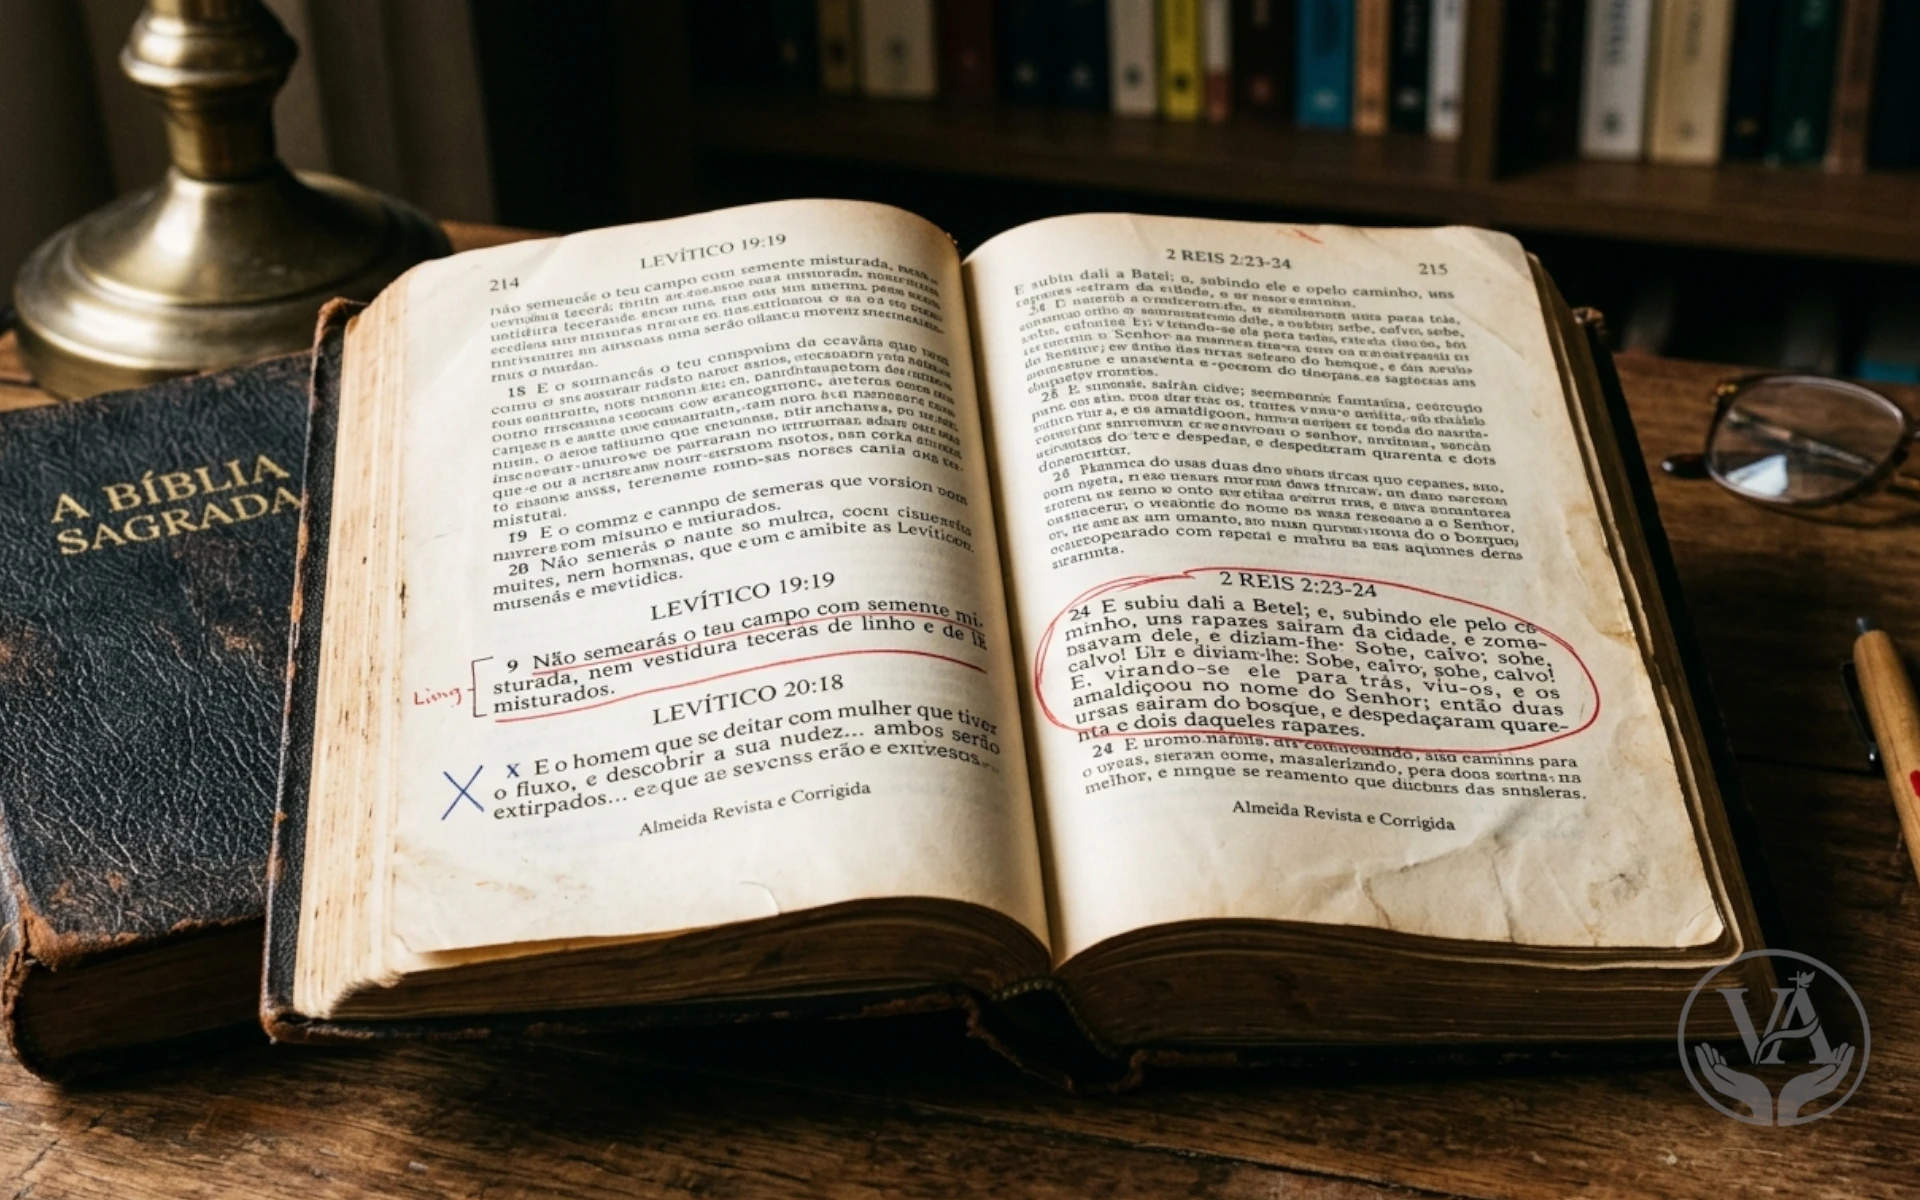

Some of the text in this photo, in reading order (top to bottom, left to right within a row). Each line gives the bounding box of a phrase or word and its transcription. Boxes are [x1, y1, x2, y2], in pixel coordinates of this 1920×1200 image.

[640, 234, 786, 270] LEVÍTICO 19:19
[1166, 249, 1176, 260] 2
[1181, 250, 1224, 264] REIS
[1418, 263, 1448, 276] 215
[489, 277, 520, 292] 214
[644, 276, 698, 293] campo
[51, 454, 290, 524] A BÍBLIA
[56, 486, 301, 555] SAGRADA
[540, 527, 552, 539] E
[649, 571, 835, 621] LEVÍTICO 19:19
[1219, 571, 1232, 586] 2
[1238, 572, 1295, 591] REIS
[1065, 615, 1137, 641] minho,
[1146, 615, 1182, 626] uns
[1277, 618, 1344, 636] sairam
[1352, 624, 1377, 639] da
[1385, 628, 1456, 646] cidade,
[1465, 635, 1475, 645] e
[1068, 605, 1091, 622] 24
[1101, 598, 1116, 614] E
[1124, 595, 1177, 610] subiu
[1233, 601, 1245, 611] a
[1253, 597, 1310, 619] Betel;
[1317, 608, 1334, 620] e,
[1343, 607, 1422, 625] subindo
[1429, 614, 1456, 628] ele
[1465, 617, 1507, 634] pelo
[532, 649, 576, 669] Não
[583, 630, 677, 661] semearás
[683, 629, 696, 642] o
[703, 622, 735, 637] teu
[741, 607, 810, 629] campo
[817, 601, 860, 615] com
[868, 600, 950, 617] semente
[1151, 629, 1221, 645] dele, e
[493, 668, 578, 695] sturada,
[588, 659, 633, 680] nem
[643, 640, 738, 669] vestidura
[828, 616, 853, 633] de
[862, 615, 916, 632] linho
[923, 622, 934, 633] e
[943, 624, 964, 641] de
[1068, 649, 1126, 673] calvo!
[1494, 668, 1555, 684] calvo!
[1073, 678, 1564, 716] amaldiçoou no nome do Senhor; então duas
[1105, 660, 1230, 681] virando-se
[1248, 664, 1280, 678] ele
[1296, 670, 1347, 684] para
[1423, 678, 1501, 698] viu-os,
[1513, 686, 1525, 698] e
[1536, 688, 1560, 699] os
[493, 685, 615, 714] misturados.
[652, 674, 844, 726] LEVÍTICO 20:18
[1075, 701, 1129, 725] ursas
[1214, 695, 1240, 710] do
[1247, 696, 1326, 718] bosque,
[1331, 707, 1342, 717] e
[1349, 706, 1495, 730] despedaçaram
[1500, 719, 1569, 734] quare-
[534, 758, 549, 775] E
[555, 760, 567, 772] o
[573, 745, 650, 769] homem
[655, 735, 693, 756] que
[698, 730, 718, 745] se
[723, 716, 783, 739] deitar
[788, 708, 832, 726] com
[838, 699, 912, 719] mulher
[917, 704, 953, 721] que
[1134, 713, 1177, 729] dois
[1184, 712, 1275, 730] daqueles
[494, 788, 507, 800] o
[516, 780, 577, 798] fluxo,
[586, 774, 598, 786] e
[606, 750, 705, 783] descobrir
[714, 749, 725, 761] a
[735, 738, 770, 756] sua
[780, 725, 864, 748] nudez...
[874, 720, 944, 738] ambos
[493, 793, 627, 820] extirpados...
[870, 743, 882, 754] e
[639, 781, 871, 837] Almeida Revista e Corrigida
[1232, 800, 1456, 832] Almeida Revista e Corrigida
